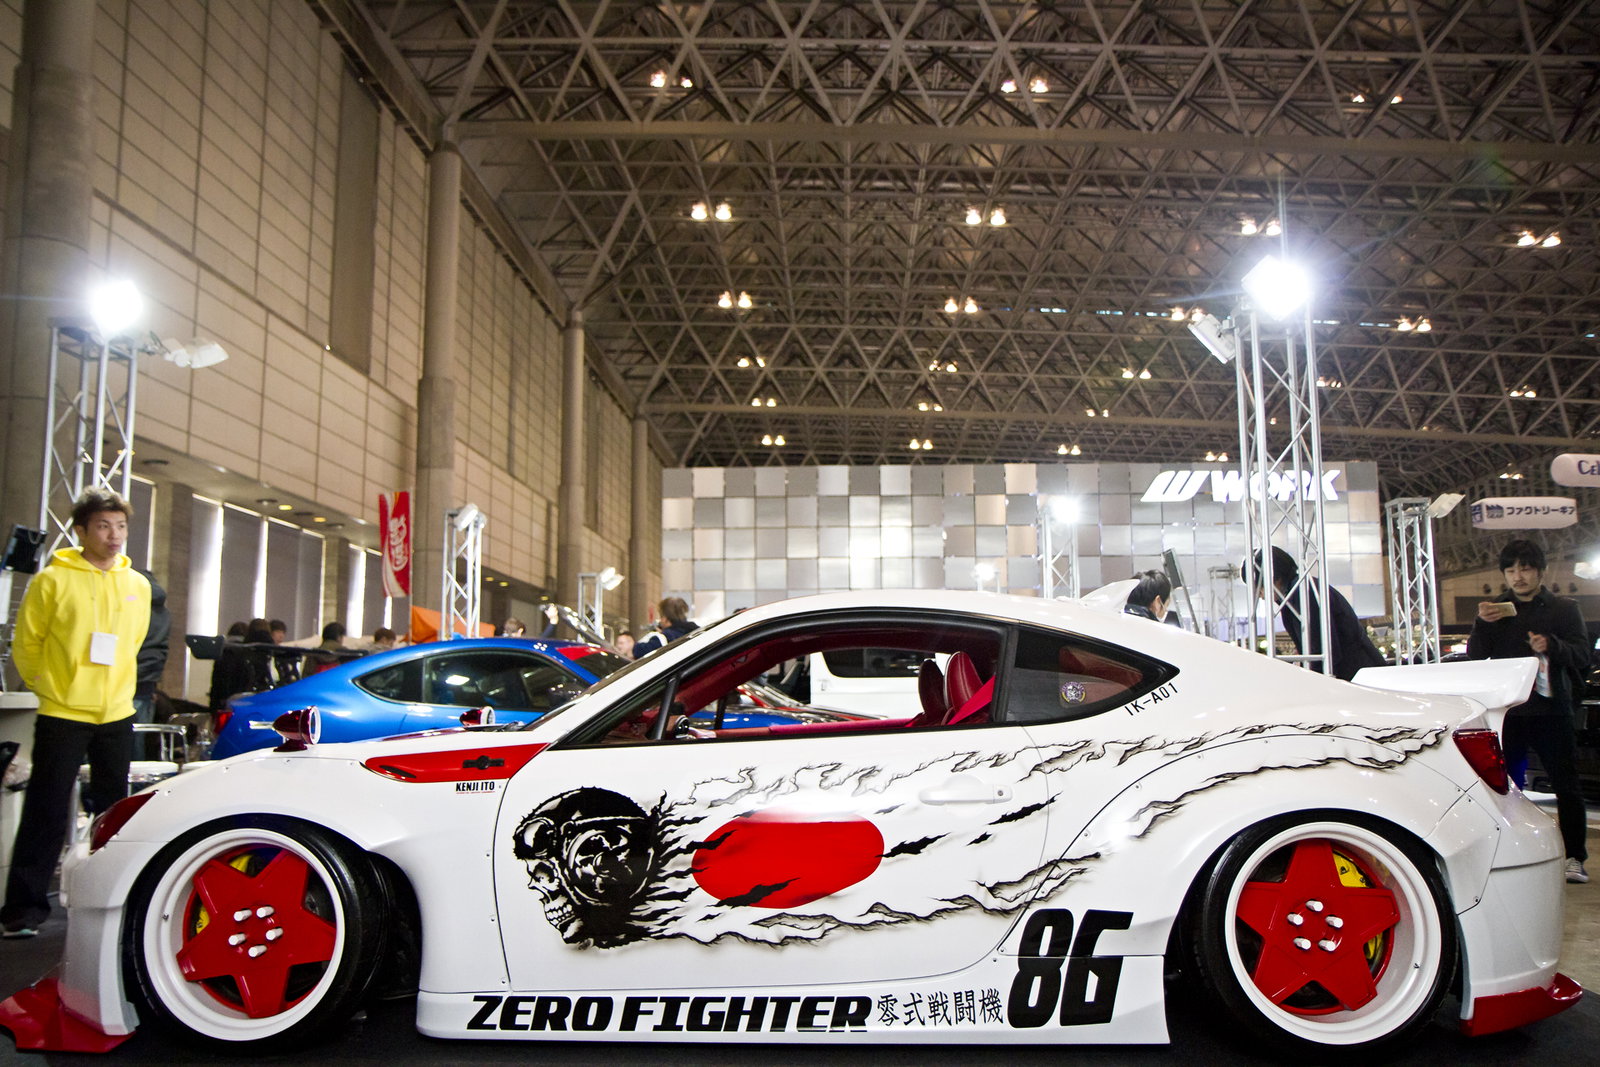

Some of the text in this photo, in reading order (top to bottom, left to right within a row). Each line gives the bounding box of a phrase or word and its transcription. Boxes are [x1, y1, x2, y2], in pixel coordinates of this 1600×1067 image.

[1211, 470, 1341, 502] WORK
[1124, 682, 1178, 716] IK-A01
[456, 781, 495, 792] KENJI ITO
[1007, 908, 1134, 1028] 86
[466, 995, 873, 1032] ZERO FIGHTER
[876, 988, 1004, 1027] 零式戦闘機
